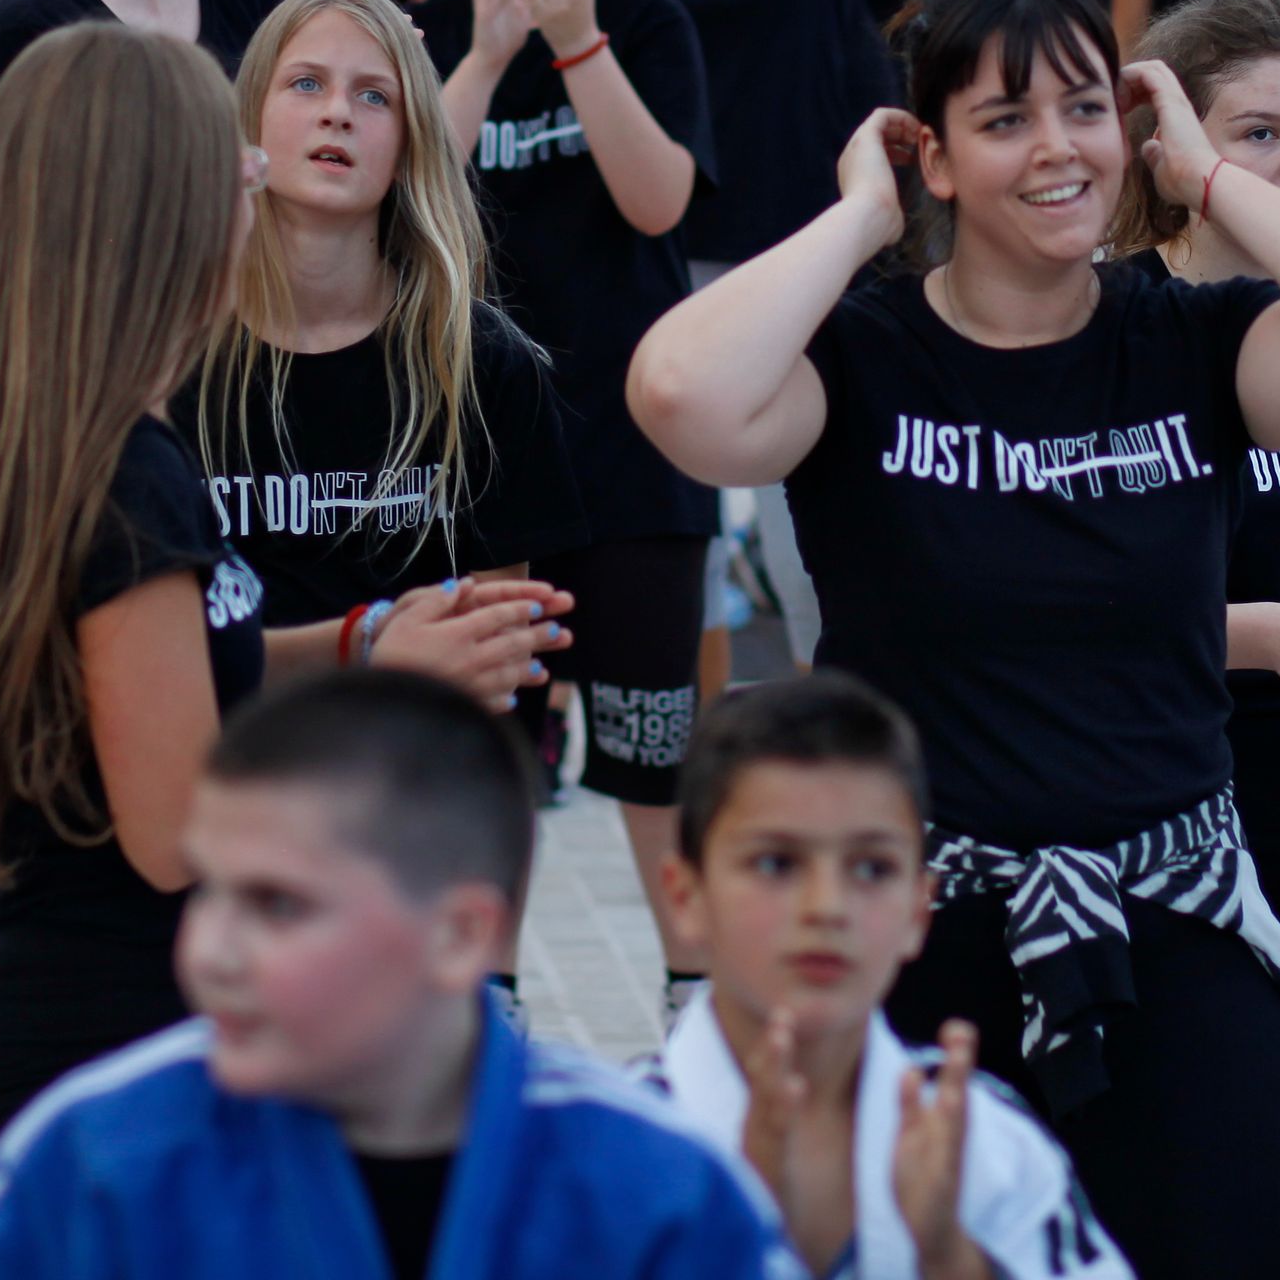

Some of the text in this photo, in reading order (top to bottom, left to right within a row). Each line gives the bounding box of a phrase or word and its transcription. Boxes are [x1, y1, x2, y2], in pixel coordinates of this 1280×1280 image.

[882, 414, 1213, 501] JUST DON'T QUIT.
[264, 472, 368, 536] DON'T
[591, 682, 695, 714] HILFIGE
[625, 710, 694, 746] 198
